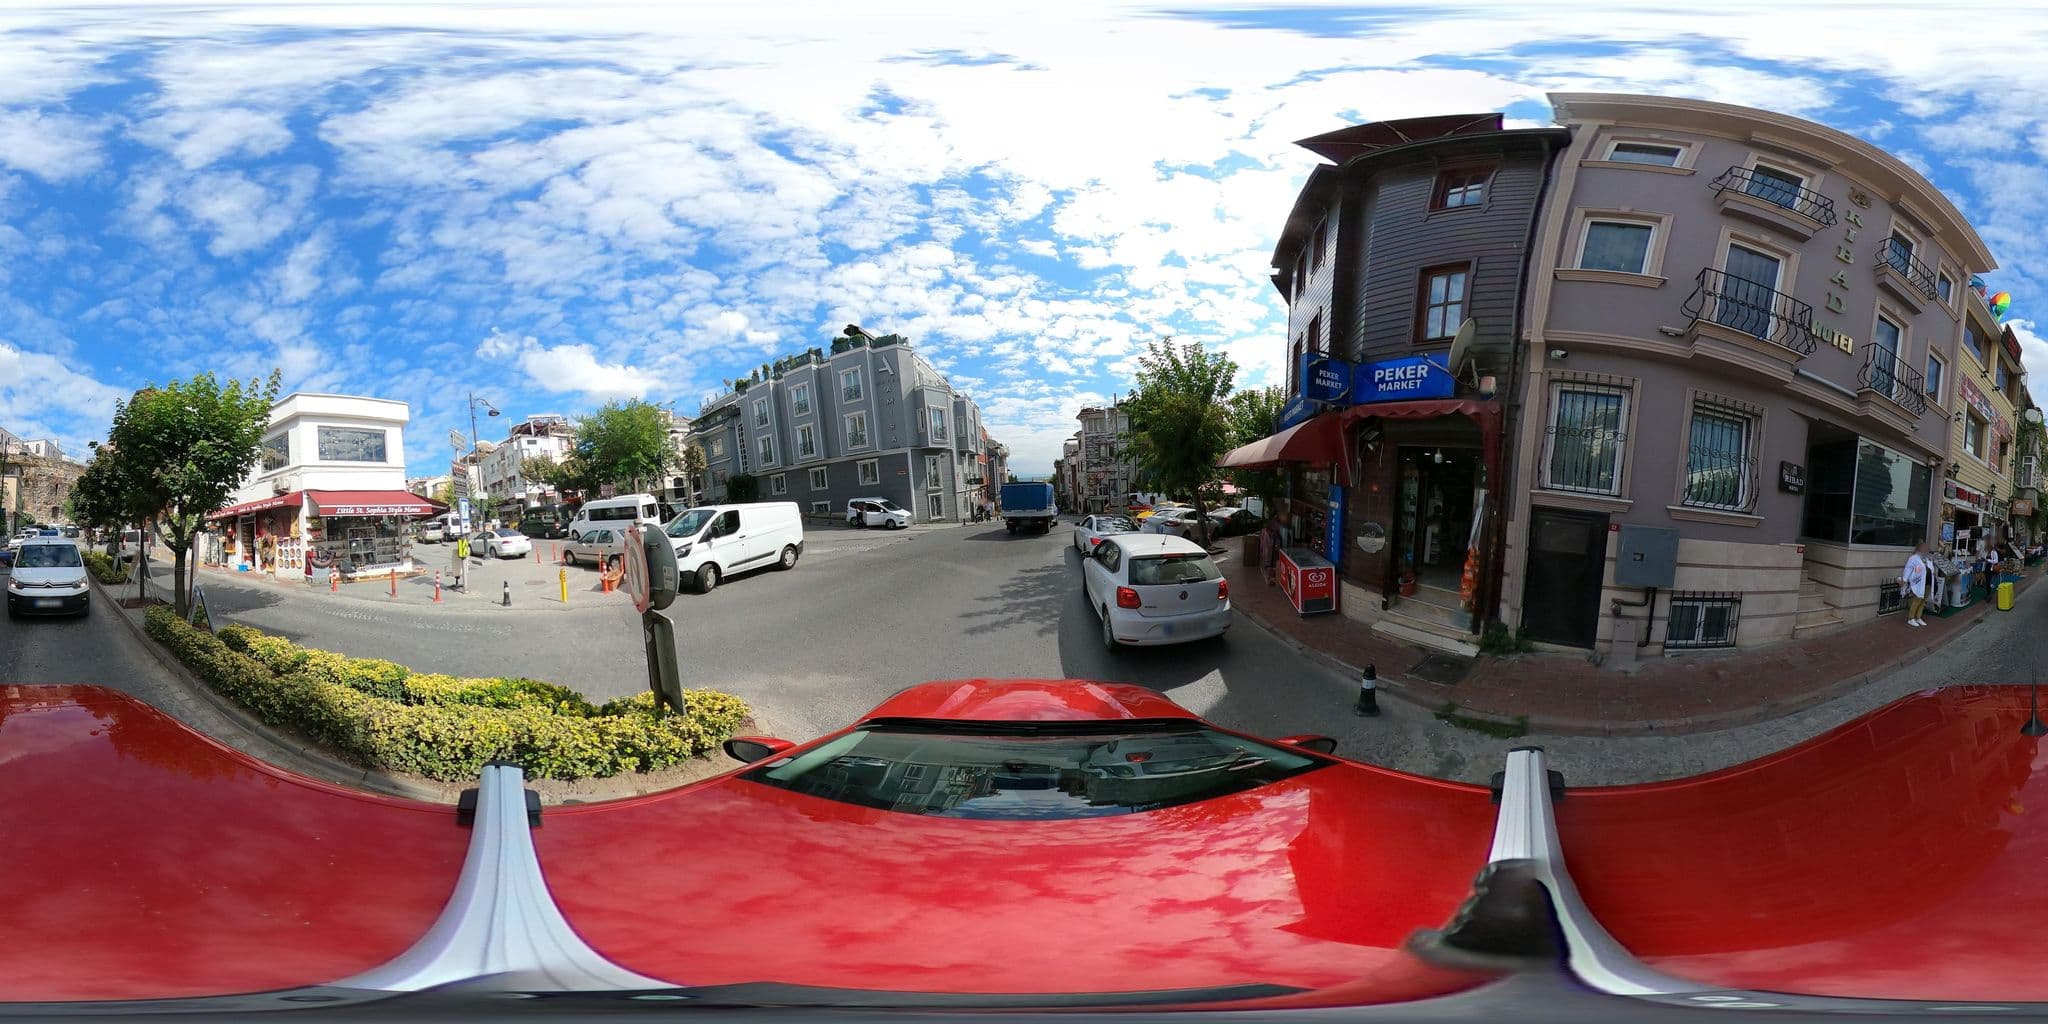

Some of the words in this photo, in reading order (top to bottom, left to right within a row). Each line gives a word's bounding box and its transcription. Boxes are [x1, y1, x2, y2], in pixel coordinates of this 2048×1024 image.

[1811, 320, 1854, 356] HOTEL
[1319, 370, 1338, 380] PEKER
[1374, 365, 1428, 383] PEKER
[1315, 378, 1342, 389] MARKET
[1378, 379, 1422, 392] MARKET
[366, 506, 386, 514] Sophia
